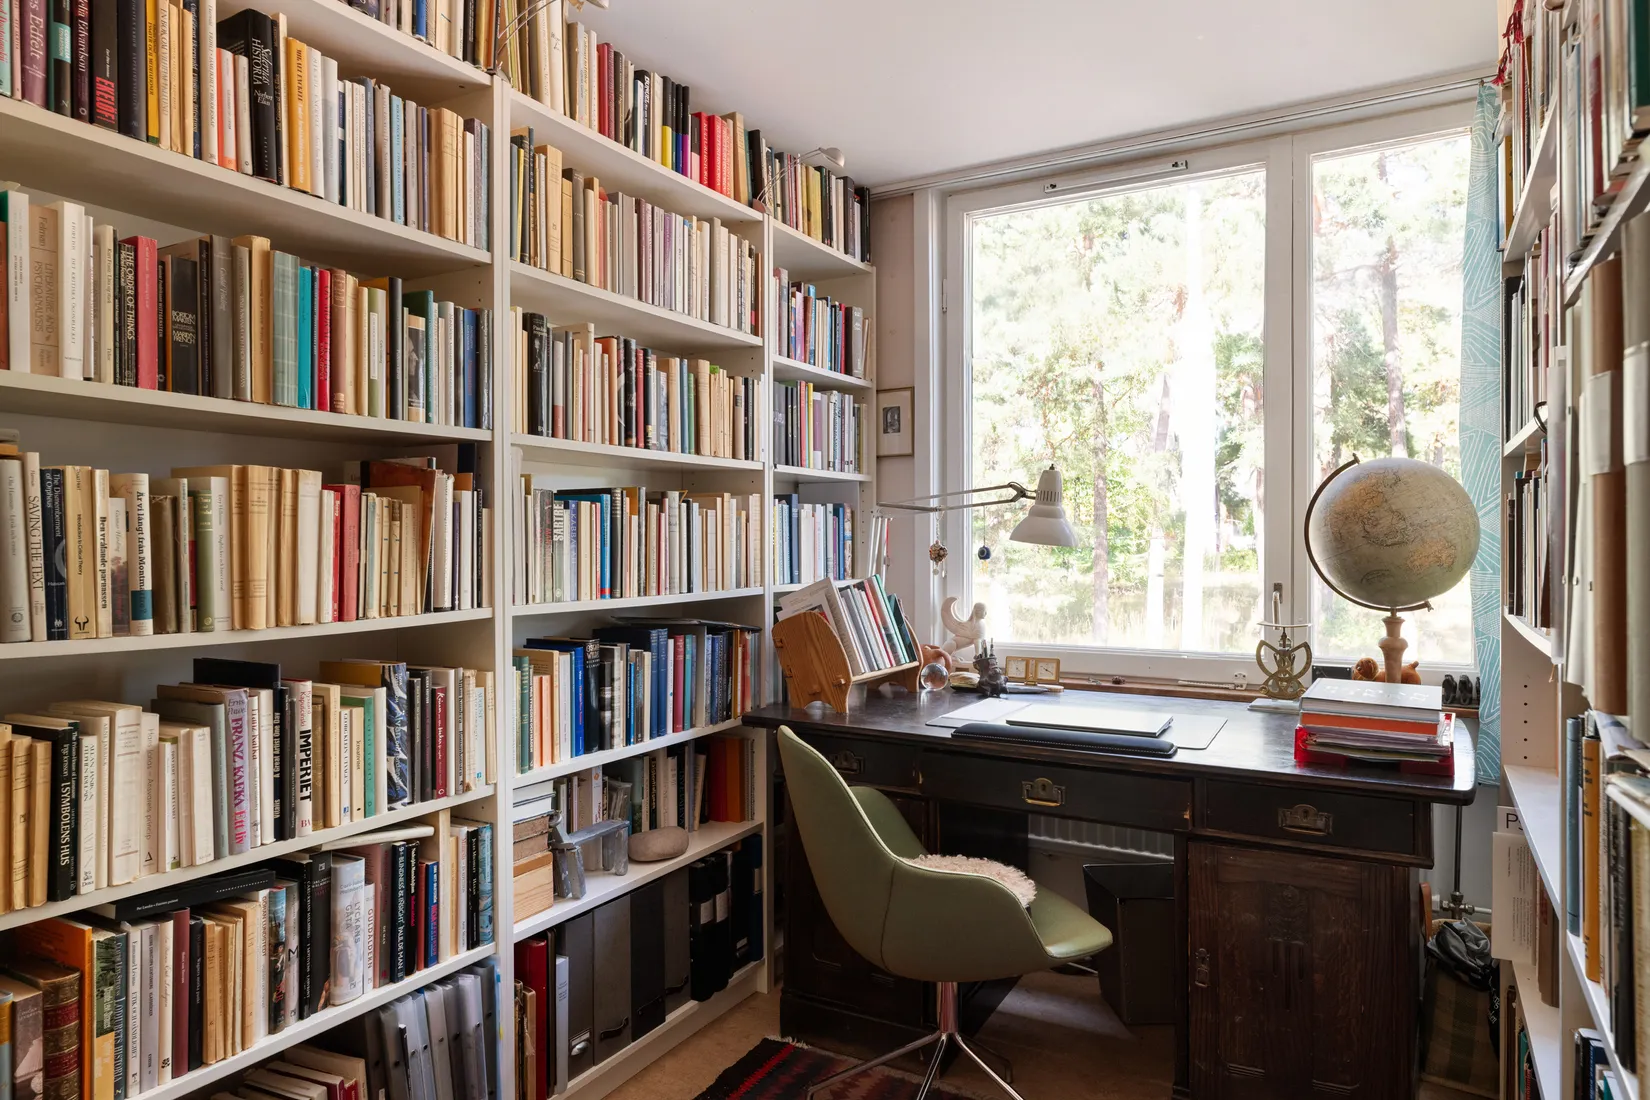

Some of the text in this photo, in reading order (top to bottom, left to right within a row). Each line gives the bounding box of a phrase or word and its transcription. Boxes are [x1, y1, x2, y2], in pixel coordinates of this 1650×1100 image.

[30, 13, 44, 60] Edfelt
[78, 20, 88, 72] Edvardson
[251, 37, 262, 86] HISTORIA
[260, 44, 272, 85] Sedernas
[96, 76, 117, 124] EKELÖF!
[39, 216, 48, 246] Felman
[34, 261, 43, 332] PSYCHOANALYSIS
[45, 263, 55, 334] LITERATURE AND
[126, 251, 135, 340] THE ORDER OF THINGS
[44, 481, 53, 508] Orpheus
[136, 492, 145, 502] Är
[137, 504, 145, 512] vi
[135, 513, 146, 535] långt
[553, 504, 564, 541] SARTRE
[28, 496, 43, 592] SAVING THE TEXT
[99, 516, 108, 609] Den vrålande parnassen
[138, 537, 146, 555] från
[395, 711, 405, 739] Älvan
[231, 717, 246, 844] FRANZ KAFKA Ett liv
[300, 729, 312, 802] IMPERIET
[60, 788, 70, 844] SYMBOLENS
[145, 815, 153, 840] princip
[60, 845, 70, 866] HUS
[345, 904, 354, 930] GÅTA
[398, 942, 404, 952] DE
[114, 1045, 123, 1082] HISTORIA
